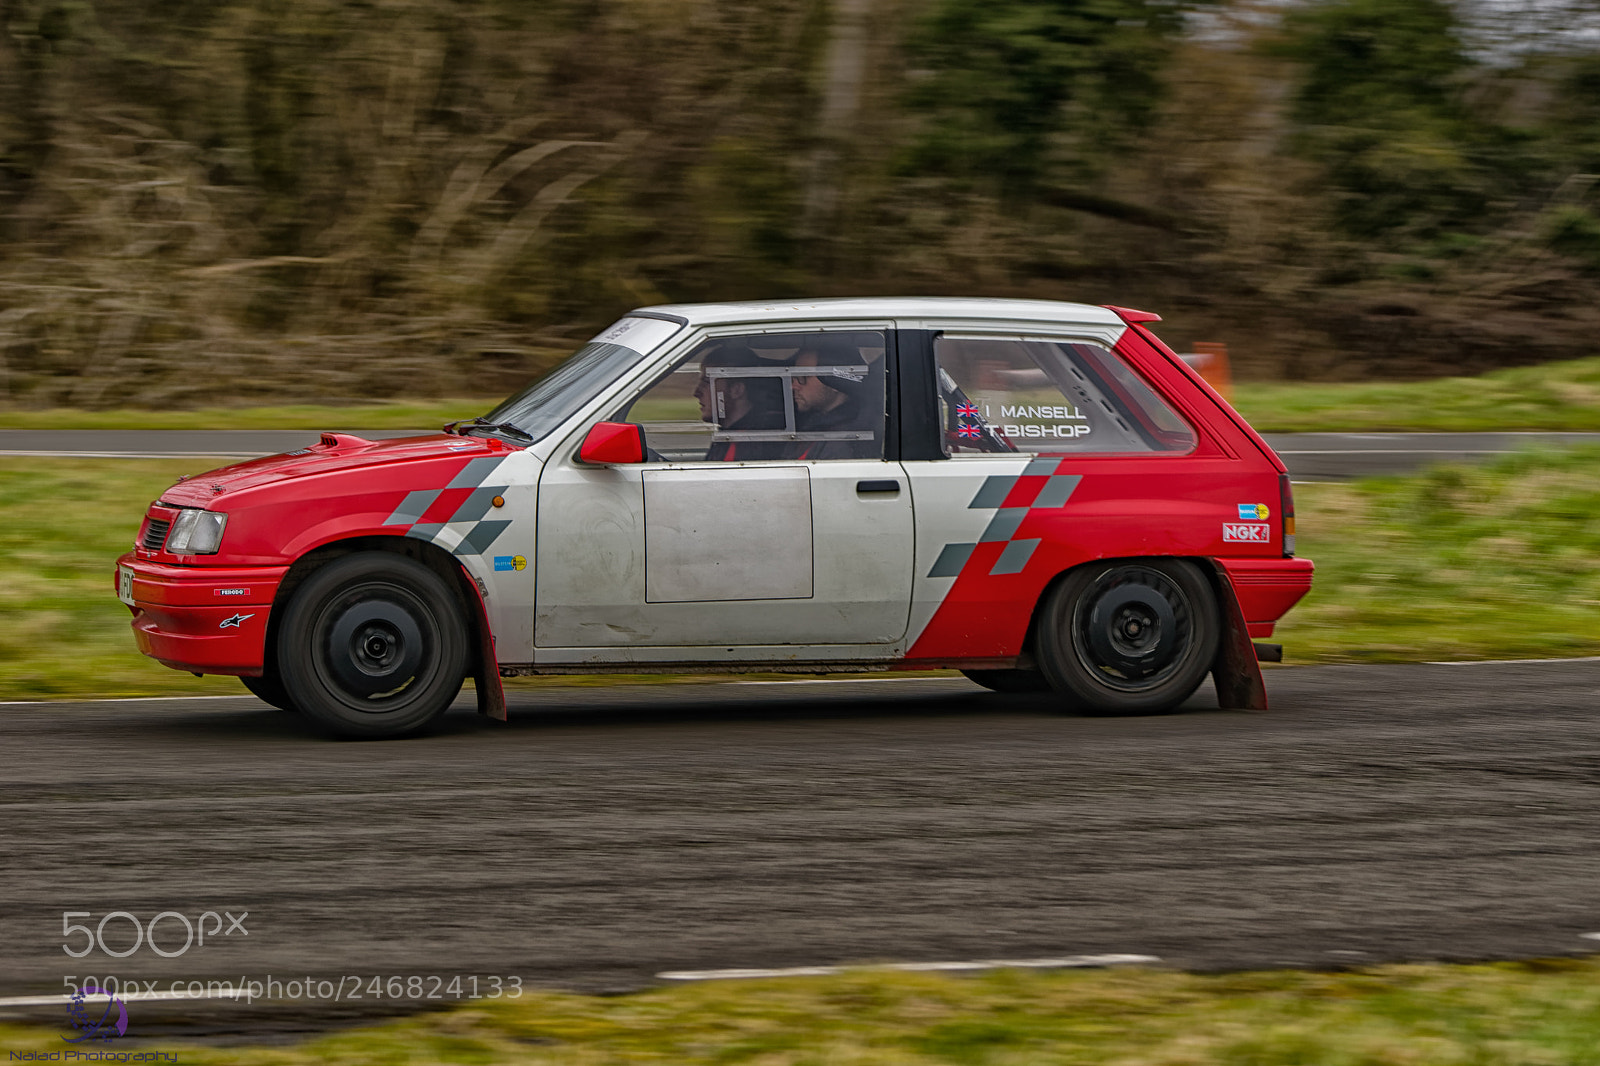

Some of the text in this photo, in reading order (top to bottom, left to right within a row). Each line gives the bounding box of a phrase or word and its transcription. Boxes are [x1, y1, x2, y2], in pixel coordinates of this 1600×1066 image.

[1001, 405, 1087, 419] MANSELL
[984, 424, 1091, 438] T.BISHOP
[1225, 525, 1260, 540] NGK
